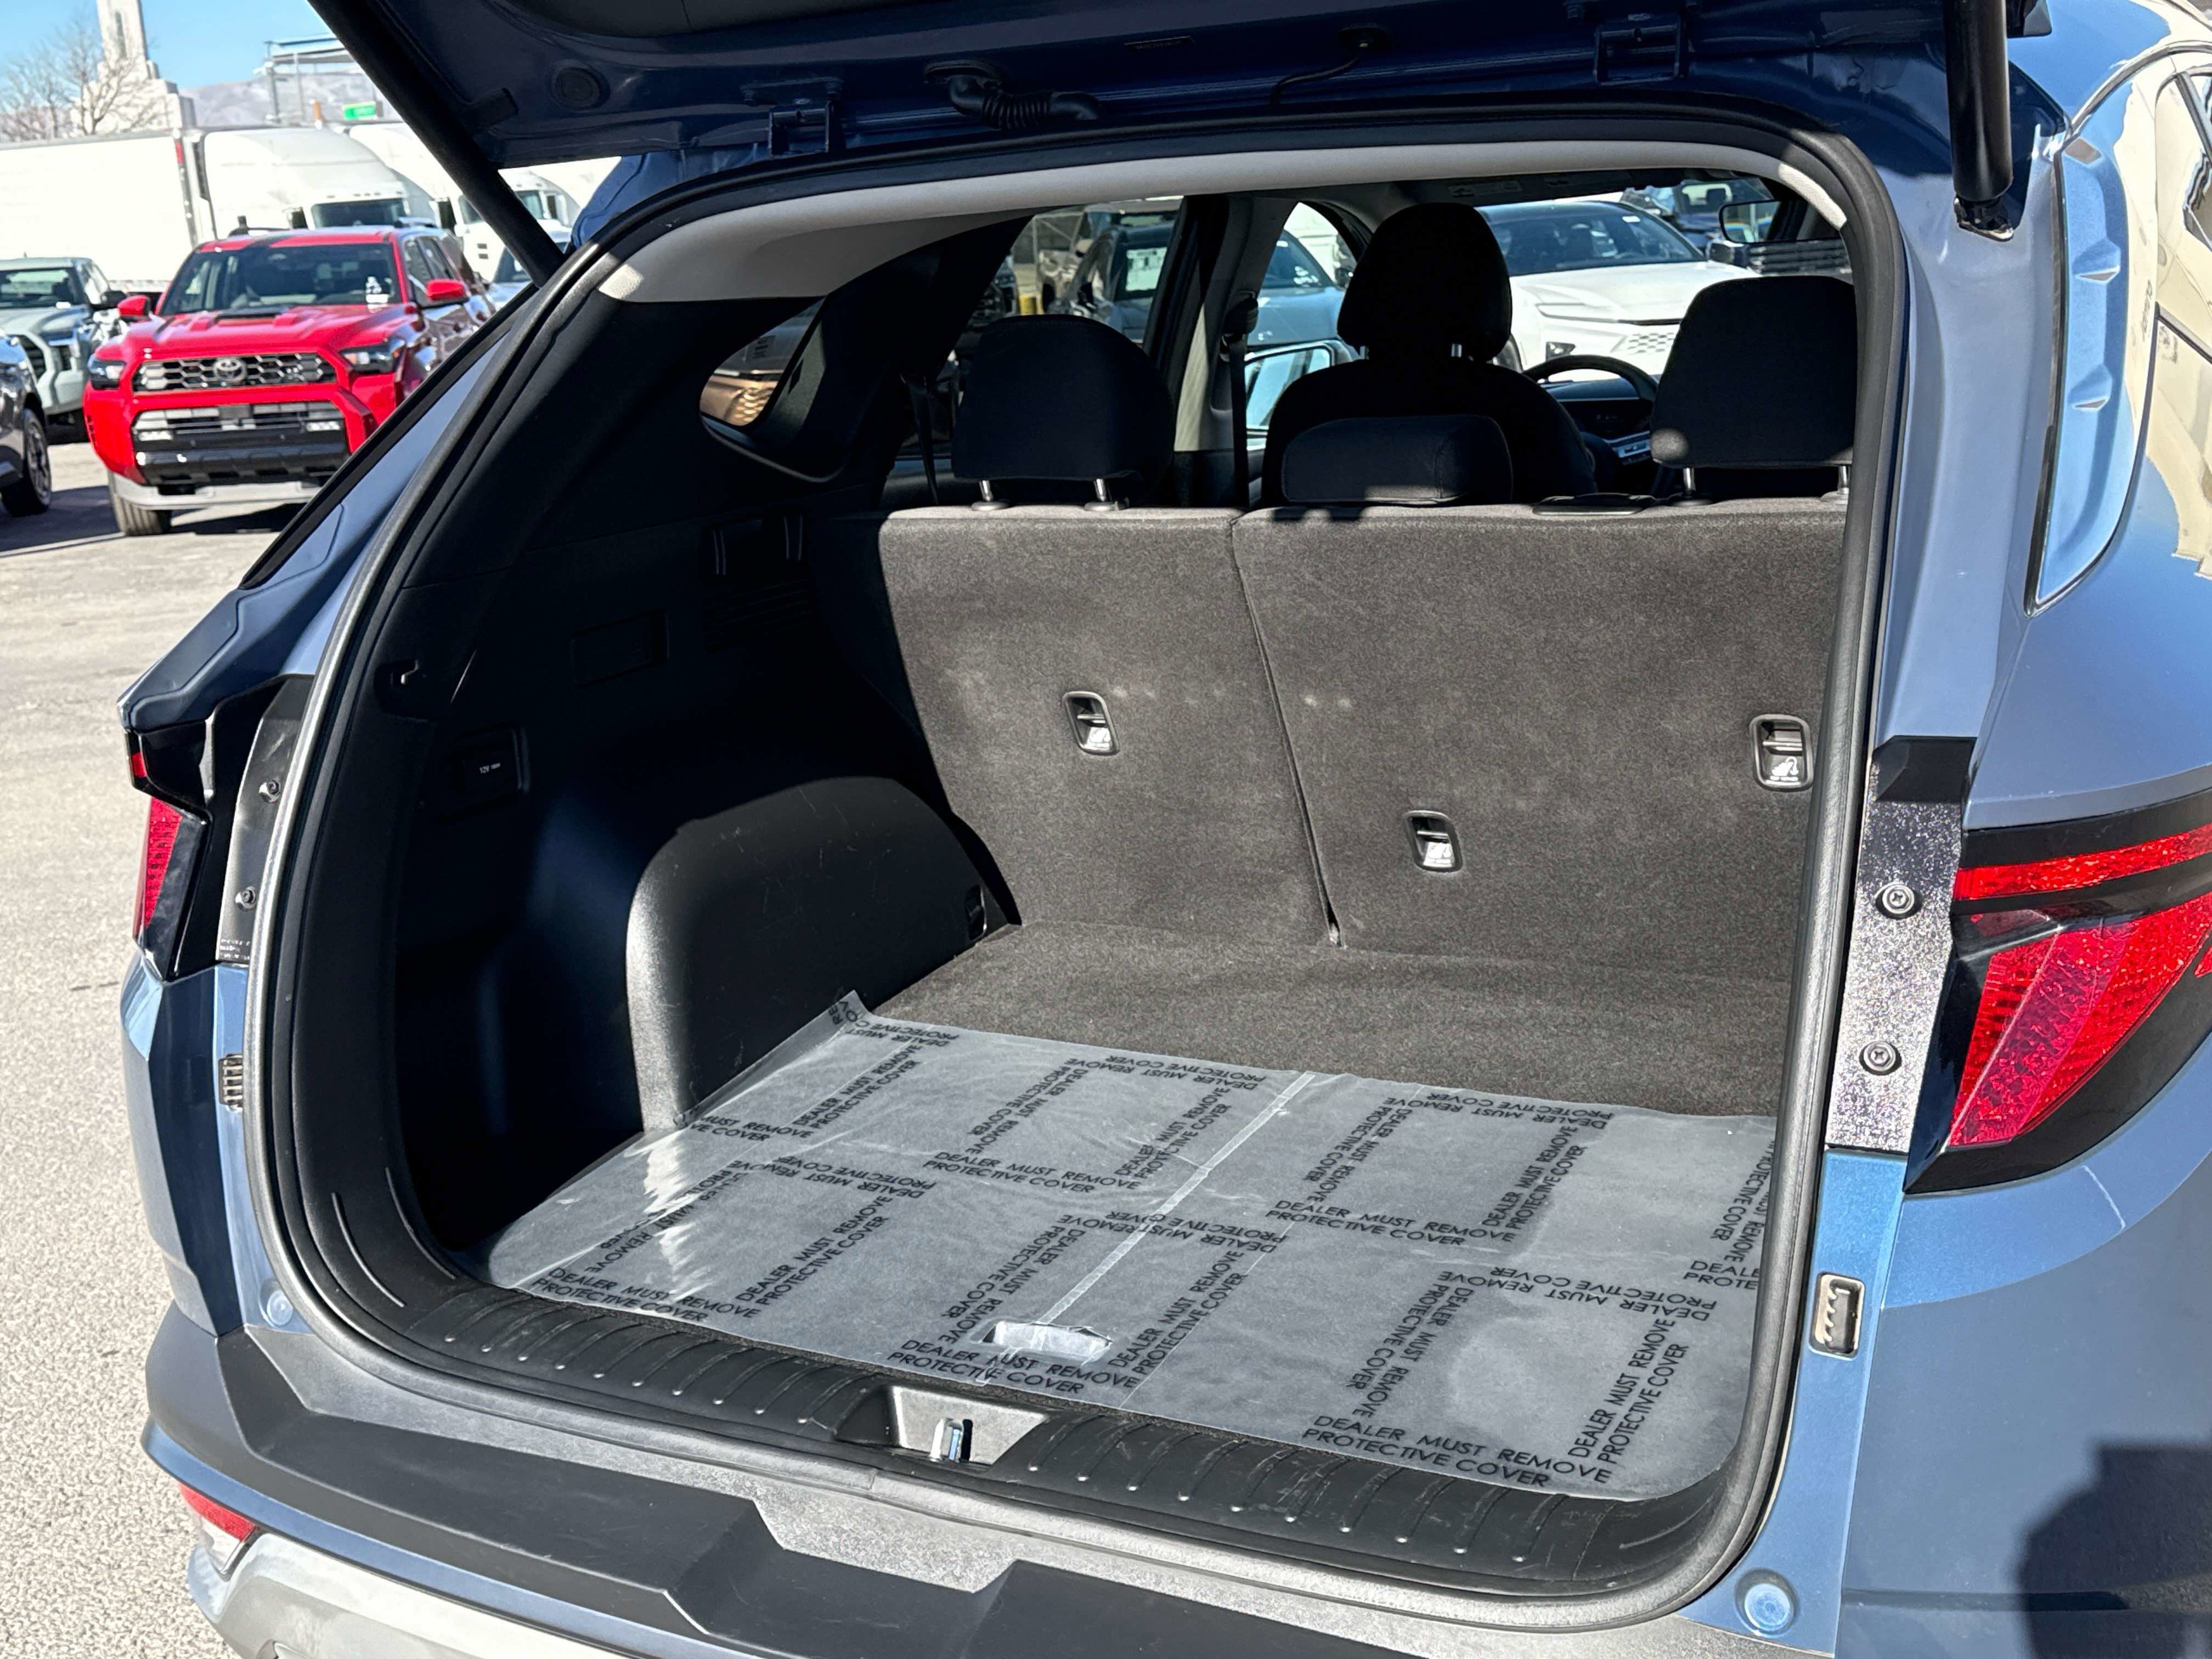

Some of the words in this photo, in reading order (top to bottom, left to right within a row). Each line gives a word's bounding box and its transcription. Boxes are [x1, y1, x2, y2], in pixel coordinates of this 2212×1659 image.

[846, 1029, 890, 1039] MUST
[870, 1024, 960, 1040] PROTECTIVE
[891, 1035, 950, 1047] DEALER
[1064, 1058, 1136, 1074] REMOVE
[1105, 1055, 1165, 1069] COVER
[1140, 1069, 1188, 1079] MUST
[1165, 1063, 1267, 1082] PROTECTIVE
[793, 1097, 842, 1125] DEALER
[840, 1076, 873, 1096] MUST
[871, 1044, 923, 1074] REMOVE
[809, 1085, 881, 1129] PROTECTIVE
[877, 1059, 921, 1085] COVER
[1006, 1066, 1072, 1108] PROTECTIVE
[1045, 1068, 1089, 1097] DEALER
[1193, 1075, 1259, 1090] DEALER
[1015, 1098, 1049, 1118] MUST
[1383, 1097, 1464, 1113] REMOVE
[1427, 1093, 1493, 1107] COVER
[1471, 1108, 1523, 1119] MUST
[1498, 1101, 1615, 1120] PROTECTIVE
[712, 1127, 770, 1141] COVER
[743, 1122, 814, 1138] REMOVE
[965, 1120, 1019, 1154] REMOVE
[967, 1108, 1012, 1136] COVER
[1114, 1143, 1156, 1177] DEALER
[1155, 1121, 1184, 1143] MUST
[1182, 1087, 1231, 1119] REMOVE
[1335, 1106, 1392, 1152] PROTECTIVE
[1372, 1108, 1413, 1138] DEALER
[1532, 1114, 1607, 1130] DEALER
[1134, 1131, 1199, 1180] PROTECTIVE
[1190, 1103, 1233, 1131] COVER
[1348, 1140, 1380, 1162] MUST
[726, 1160, 800, 1178] REMOVE
[772, 1155, 832, 1172] COVER
[833, 1166, 936, 1189] PROTECTIVE
[923, 1160, 1029, 1183] PROTECTIVE
[1029, 1177, 1096, 1193] COVER
[934, 1152, 1001, 1167] DEALER
[1006, 1163, 1057, 1176] MUST
[1061, 1171, 1141, 1190] REMOVE
[1302, 1152, 1343, 1182] COVER
[1482, 1191, 1523, 1227] DEALER
[1515, 1165, 1545, 1188] MUST
[1536, 1125, 1579, 1163] REMOVE
[803, 1172, 853, 1186] MUST
[857, 1181, 925, 1198] DEALER
[1307, 1165, 1356, 1202] REMOVE
[1505, 1176, 1562, 1230] PROTECTIVE
[1550, 1145, 1588, 1176] COVER
[1057, 1214, 1137, 1234] REMOVE
[1105, 1211, 1167, 1223] COVER
[1138, 1224, 1194, 1240] MUST
[1167, 1217, 1288, 1243] PROTECTIVE
[1265, 1210, 1386, 1235] PROTECTIVE
[1389, 1229, 1466, 1246] COVER
[1274, 1200, 1352, 1218] DEALER
[1359, 1214, 1416, 1228] MUST
[1424, 1221, 1516, 1243] REMOVE
[1710, 1206, 1746, 1241] COVER
[584, 1231, 653, 1273] REMOVE
[735, 1265, 797, 1302] DEALER
[793, 1237, 835, 1261] MUST
[832, 1195, 893, 1234] REMOVE
[988, 1225, 1065, 1282] PROTECTIVE
[1034, 1229, 1086, 1266] DEALER
[1200, 1234, 1277, 1254] DEALER
[1724, 1221, 1765, 1262] REMOVE
[755, 1248, 845, 1306] PROTECTIVE
[837, 1216, 890, 1248] COVER
[1690, 1261, 1760, 1278] DEALE
[998, 1268, 1040, 1295] MUST
[1437, 1271, 1534, 1293] REMOVE
[1490, 1266, 1571, 1287] COVER
[1683, 1272, 1759, 1290] PROTE
[532, 1278, 641, 1307] PROTECTIVE
[640, 1302, 708, 1322] COVER
[549, 1267, 618, 1291] DEALER
[620, 1285, 672, 1301] MUST
[676, 1296, 761, 1318] REMOVE
[941, 1282, 995, 1319] COVER
[1427, 1287, 1475, 1327] DEALER
[1544, 1289, 1609, 1305] MUST
[1570, 1280, 1717, 1310] PROTECTIVE
[938, 1297, 1003, 1345] REMOVE
[1107, 1327, 1164, 1368] DEALER
[1158, 1296, 1197, 1324] MUST
[1189, 1250, 1244, 1293] REMOVE
[1132, 1308, 1209, 1375] PROTECTIVE
[1200, 1272, 1249, 1310] COVER
[1384, 1284, 1449, 1346] PROTECTIVE
[1619, 1299, 1710, 1321] DEALER
[1400, 1331, 1438, 1363] MUST
[901, 1339, 980, 1362] DEALER
[1046, 1364, 1140, 1388] REMOVE
[1345, 1348, 1395, 1390] COVER
[1007, 1372, 1084, 1394] COVER
[1352, 1366, 1409, 1418] REMOVE
[1567, 1409, 1617, 1457] DEALER
[1605, 1373, 1640, 1406] MUST
[1628, 1319, 1676, 1368] REMOVE
[1597, 1388, 1661, 1464] PROTECTIVE
[1647, 1344, 1690, 1387] COVER
[1302, 1429, 1451, 1466] PROTECTIVE
[1456, 1459, 1551, 1487] COVER
[1313, 1415, 1405, 1440] DEALER
[1416, 1435, 1486, 1457] MUST
[1497, 1448, 1612, 1483] REMOVE
